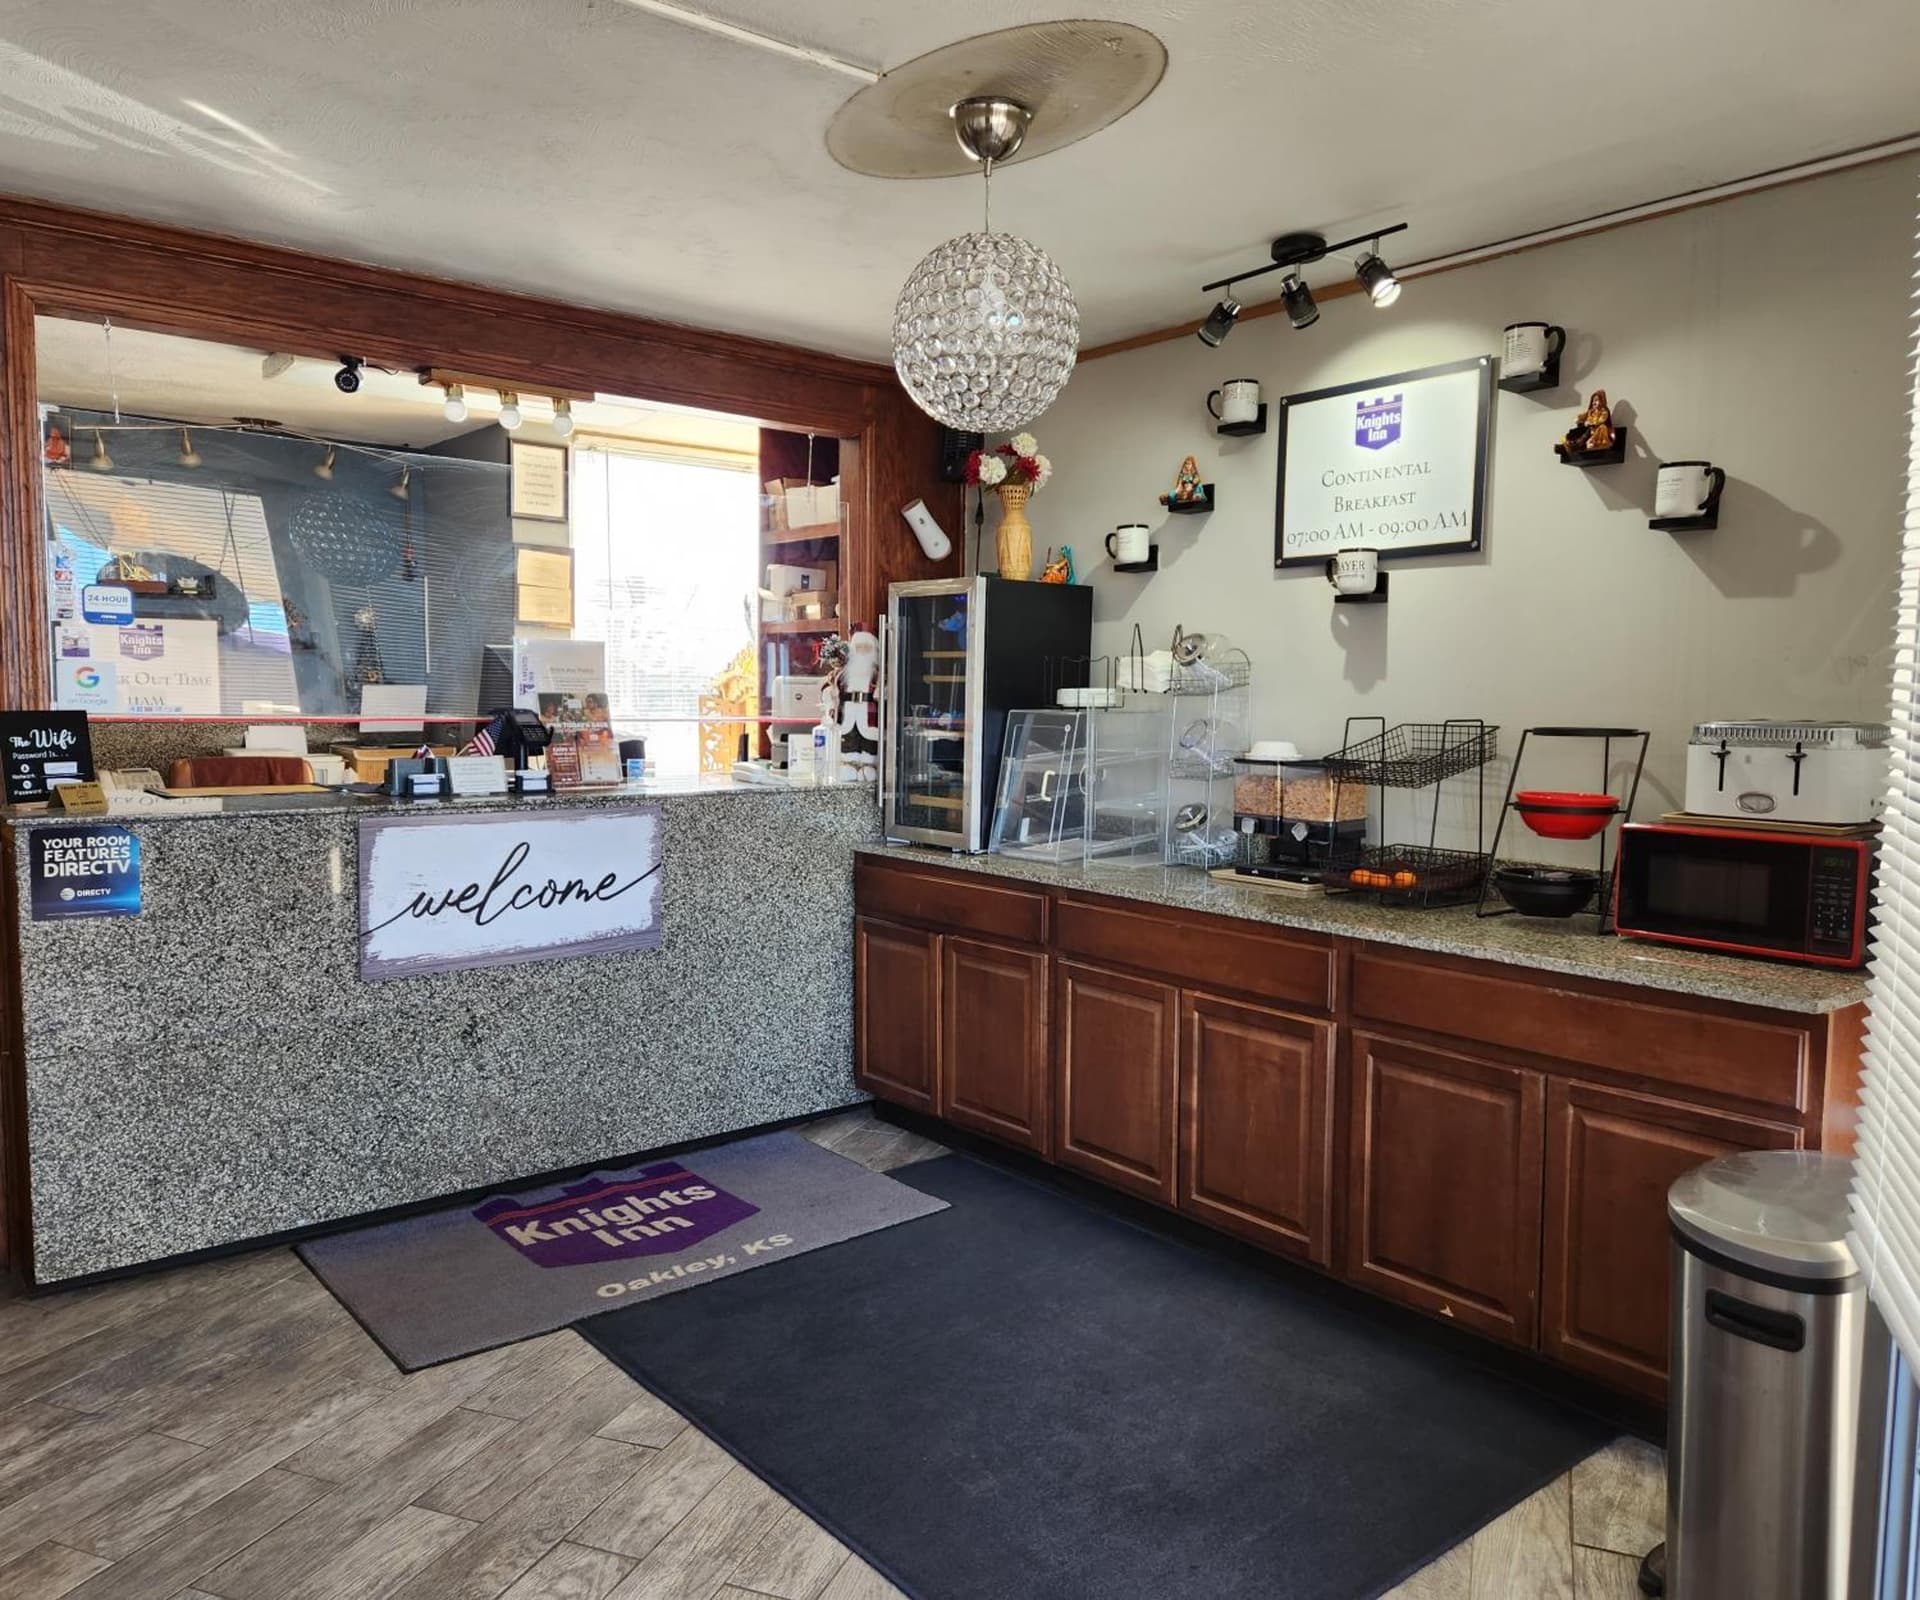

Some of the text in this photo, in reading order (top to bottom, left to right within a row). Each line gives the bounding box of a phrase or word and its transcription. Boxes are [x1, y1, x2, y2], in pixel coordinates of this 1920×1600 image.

[1356, 411, 1401, 430] Knights
[1367, 428, 1388, 442] Inn
[1321, 461, 1432, 488] CONTINENTAL
[1334, 491, 1416, 513] BREAKFAST
[1286, 529, 1330, 547] 07:00
[1334, 522, 1364, 541] AM
[1378, 519, 1429, 540] 09:00
[1433, 510, 1468, 529] AM
[119, 635, 163, 647] Knights
[132, 645, 152, 655] Inn
[9, 728, 77, 750] The Wifi
[12, 750, 47, 760] Password
[42, 835, 131, 849] YOUR ROOM
[44, 847, 131, 863] FEATURES
[43, 859, 131, 878] DIRECTV
[76, 887, 112, 897] DIRECTV
[361, 841, 662, 936] welcome
[504, 1185, 718, 1247] Knights
[591, 1213, 695, 1248] Inn
[595, 1232, 795, 1298] Oakley, KS
